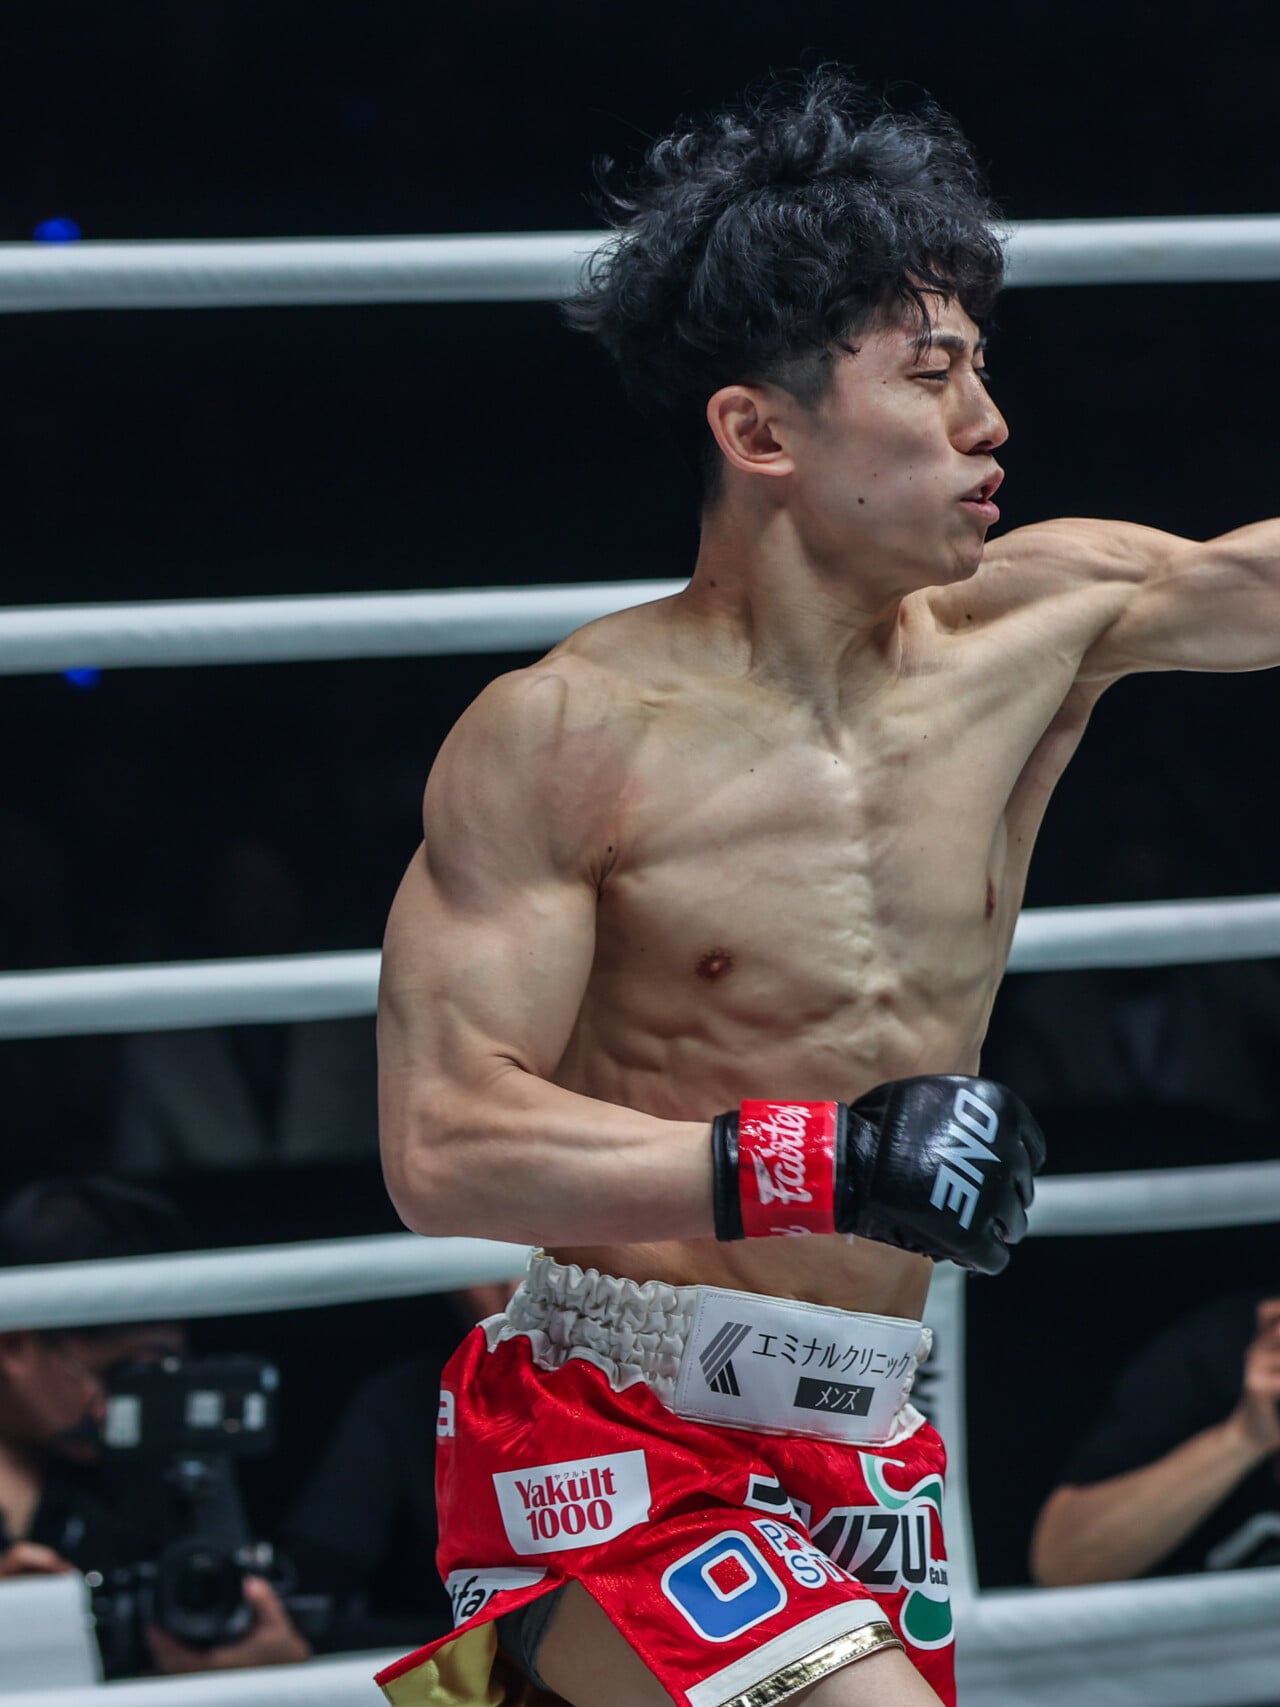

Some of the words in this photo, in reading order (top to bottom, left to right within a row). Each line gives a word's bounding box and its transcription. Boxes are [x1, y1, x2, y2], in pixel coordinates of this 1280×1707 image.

[929, 1088, 1001, 1230] ONE
[752, 1333, 911, 1379] エミナルクリニック
[815, 1385, 860, 1411] メンズ
[514, 1467, 616, 1509] Yakult
[554, 1470, 587, 1480] ヤクルト
[526, 1499, 612, 1540] 1000
